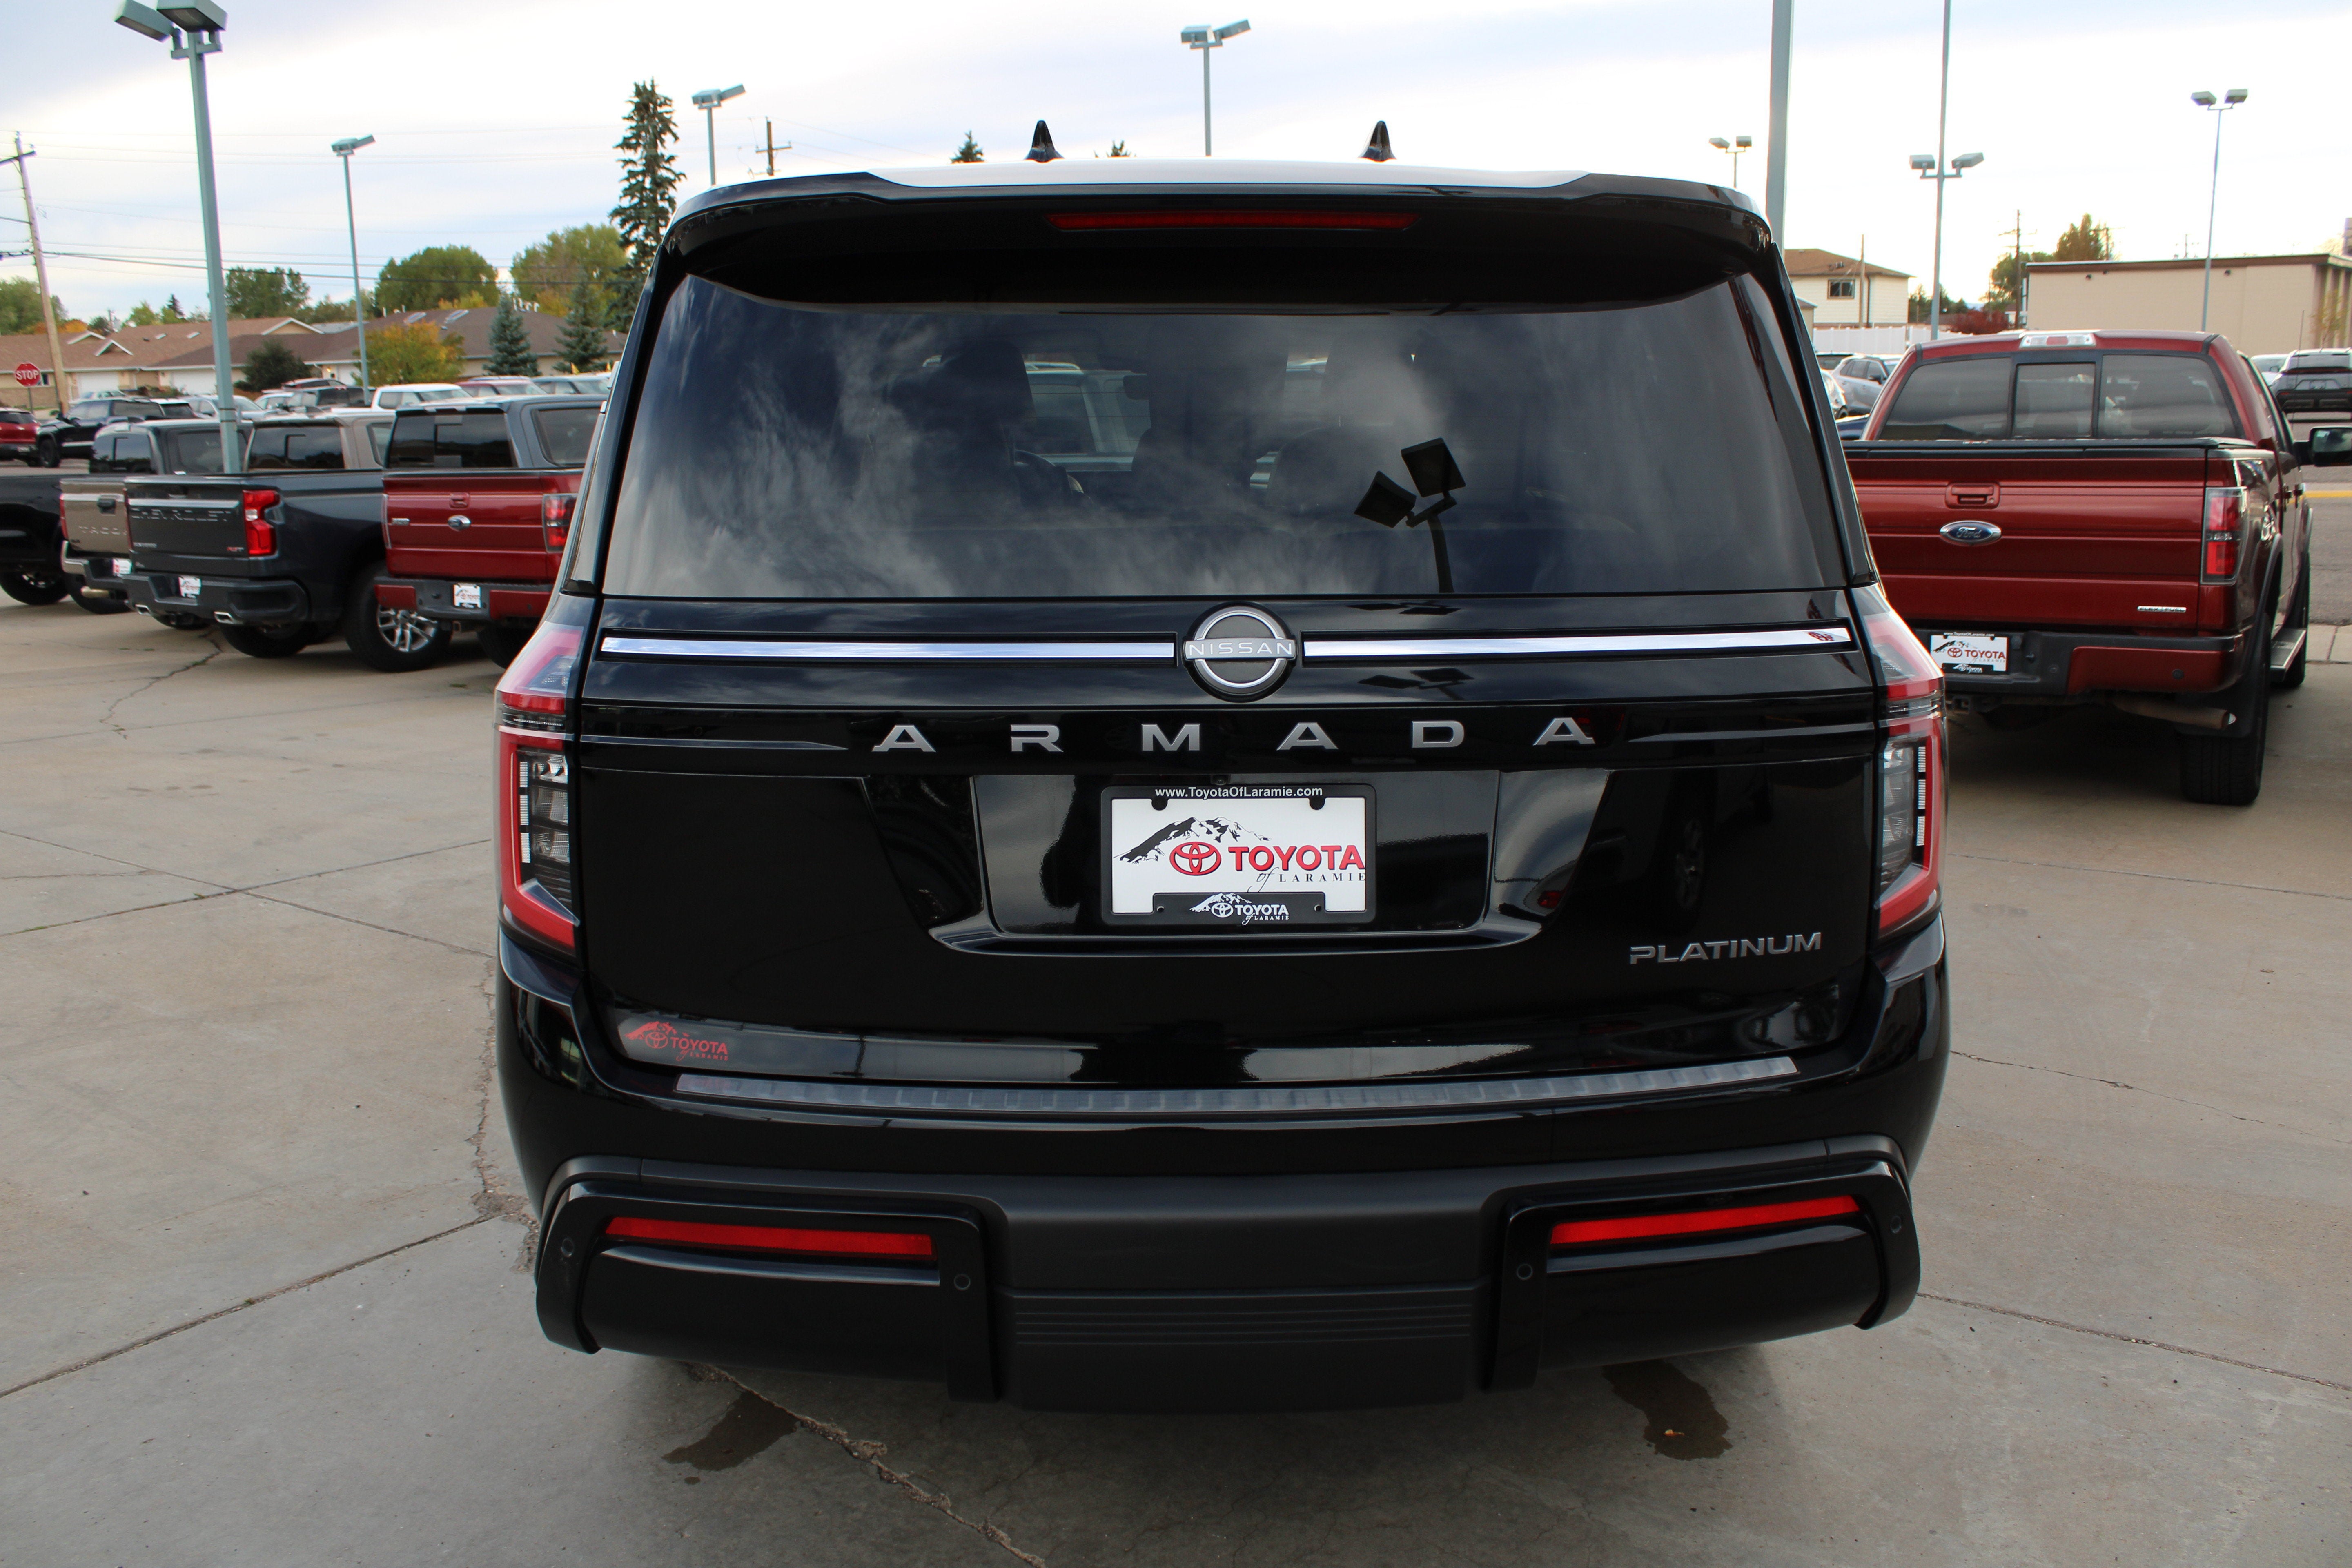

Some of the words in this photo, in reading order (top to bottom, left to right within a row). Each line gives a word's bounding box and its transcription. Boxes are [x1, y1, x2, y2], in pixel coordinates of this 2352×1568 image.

[16, 370, 38, 380] STOP
[1956, 526, 1982, 538] Ford
[1189, 642, 1292, 656] NISSAN
[1964, 650, 2006, 659] TOYOTA
[872, 717, 1596, 752] ARMADA
[1155, 786, 1323, 800] www.ToyotaOfLaramie.com
[1228, 845, 1366, 871] TOYOTA
[1247, 866, 1279, 893] of
[1279, 873, 1366, 882] LARAMIE
[1234, 904, 1290, 915] TOYOTA
[1241, 913, 1255, 926] of
[1629, 932, 1822, 964] PLATINUM
[670, 1036, 728, 1055] TOYOTA
[690, 1052, 729, 1061] LARAMIE
